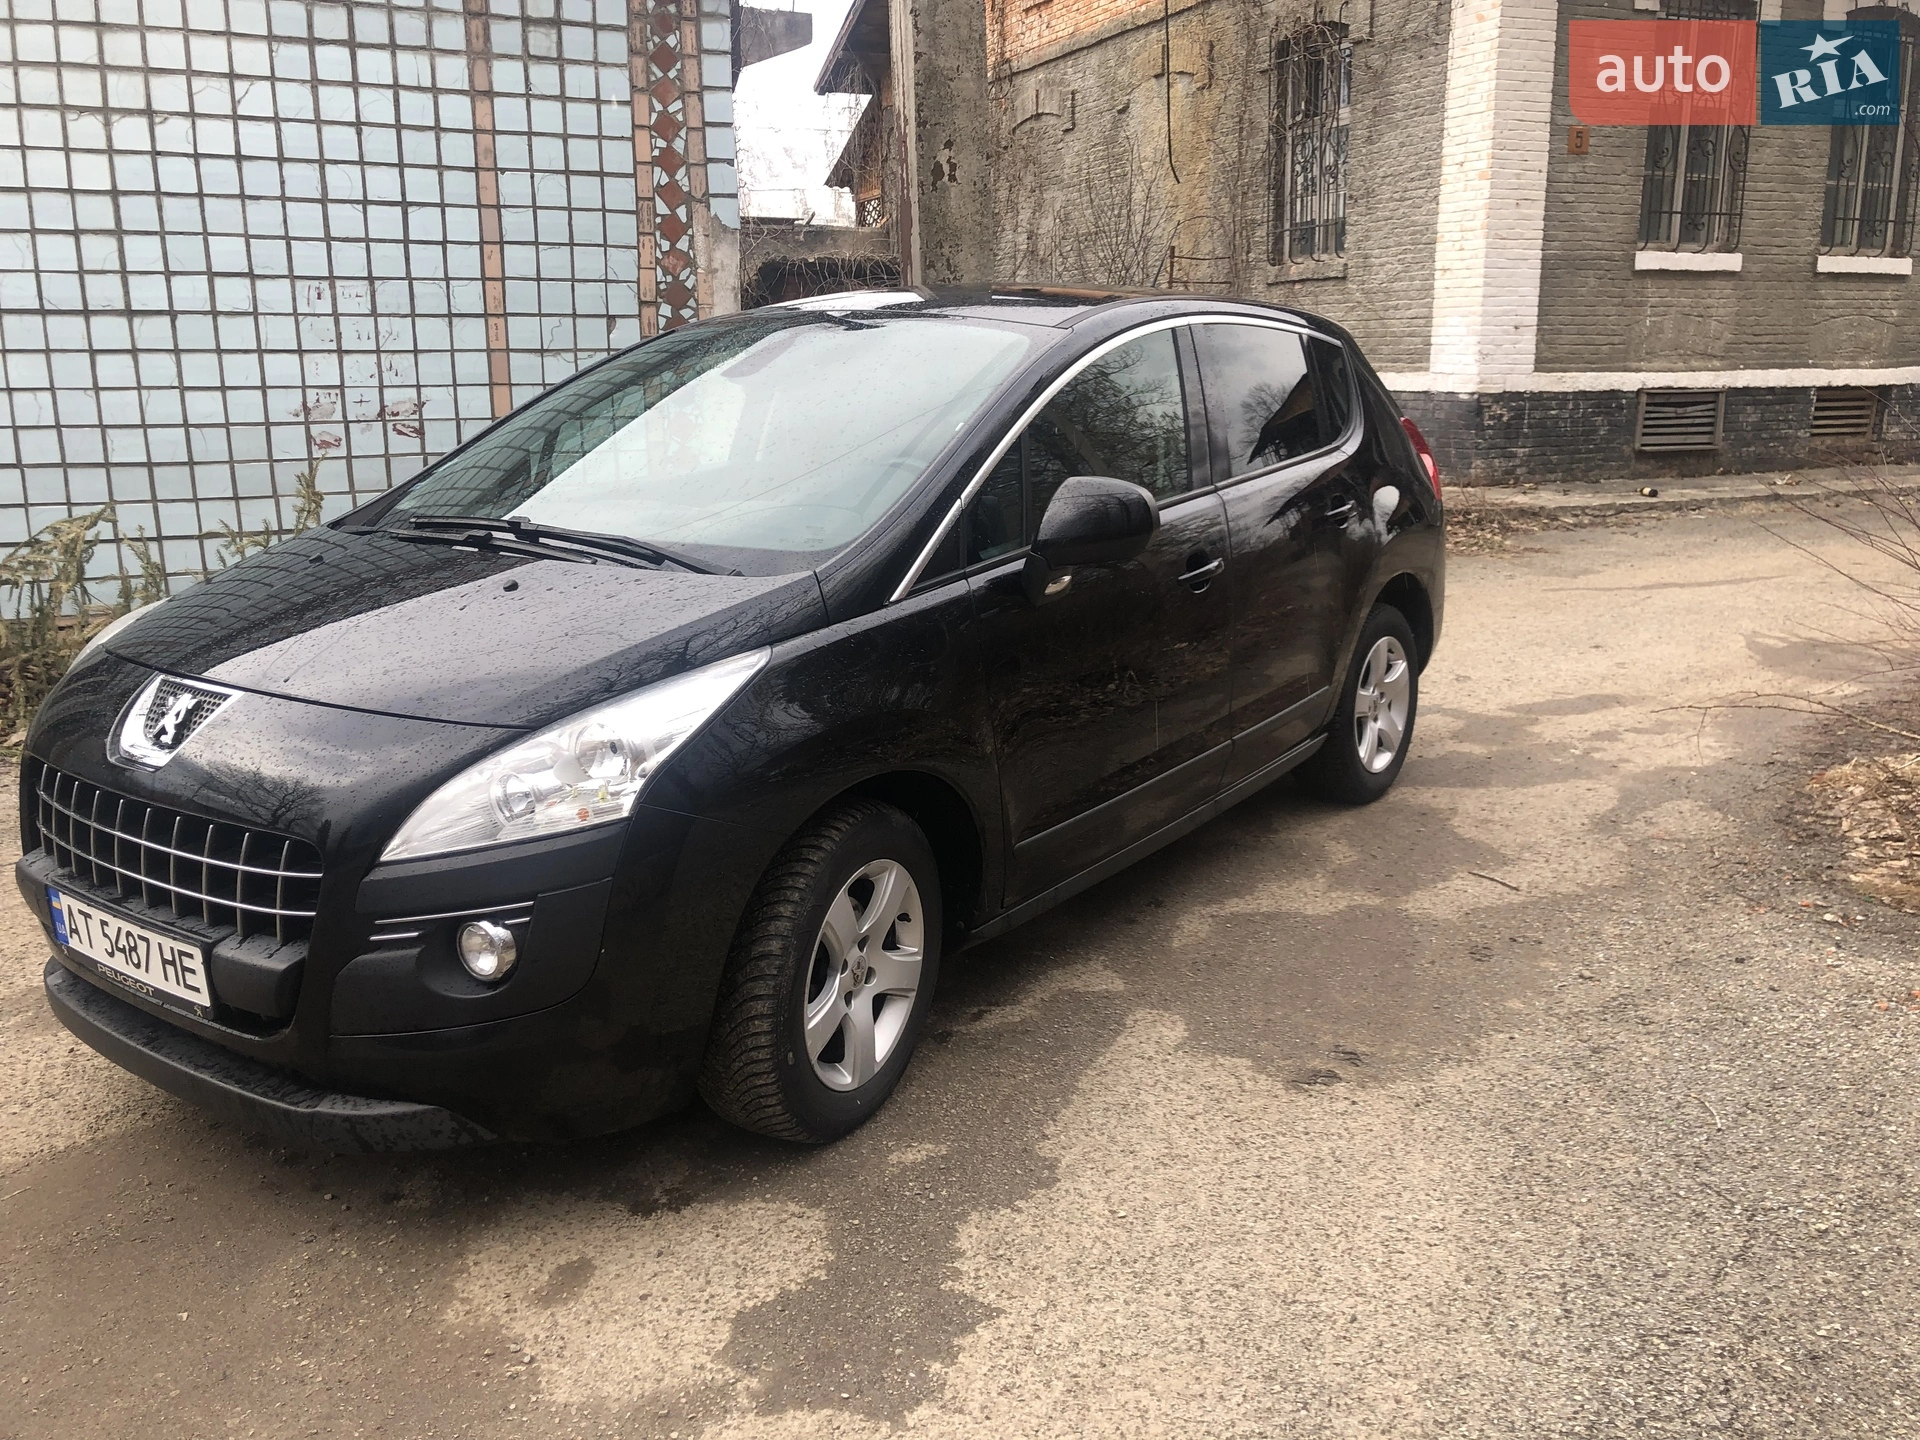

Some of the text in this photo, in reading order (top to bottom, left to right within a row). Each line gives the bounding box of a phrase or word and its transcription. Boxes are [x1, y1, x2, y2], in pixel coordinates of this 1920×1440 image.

[1574, 130, 1584, 149] 5
[55, 921, 67, 936] UA
[67, 904, 201, 994] AT 5487 HE
[97, 963, 154, 996] PEUGEOT
